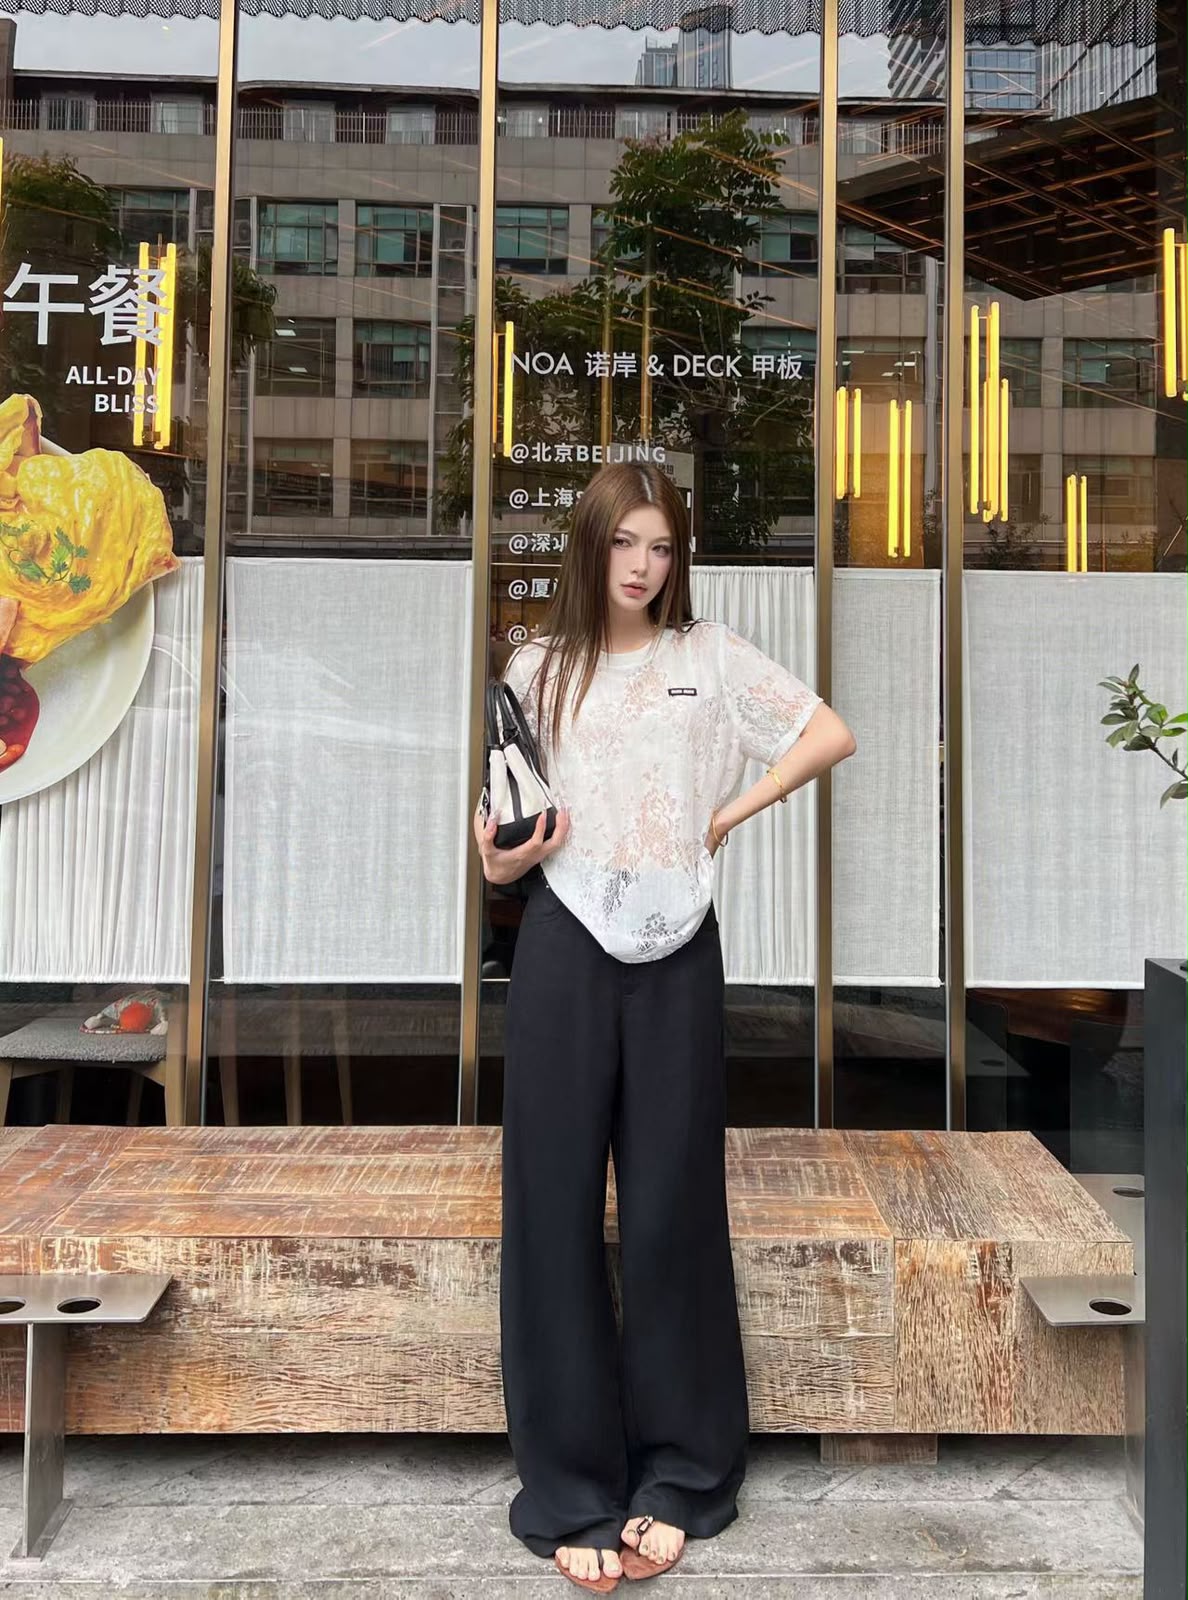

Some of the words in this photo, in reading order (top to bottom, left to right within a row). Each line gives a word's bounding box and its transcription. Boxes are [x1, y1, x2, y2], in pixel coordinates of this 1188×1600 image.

[2, 262, 171, 346] 午餐
[65, 366, 161, 385] ALL-DAY
[511, 352, 574, 374] NOA
[585, 352, 637, 378] 诺岸
[646, 355, 665, 376] &
[673, 355, 743, 377] DECK
[752, 354, 803, 380] 甲板
[95, 394, 160, 413] BLISS
